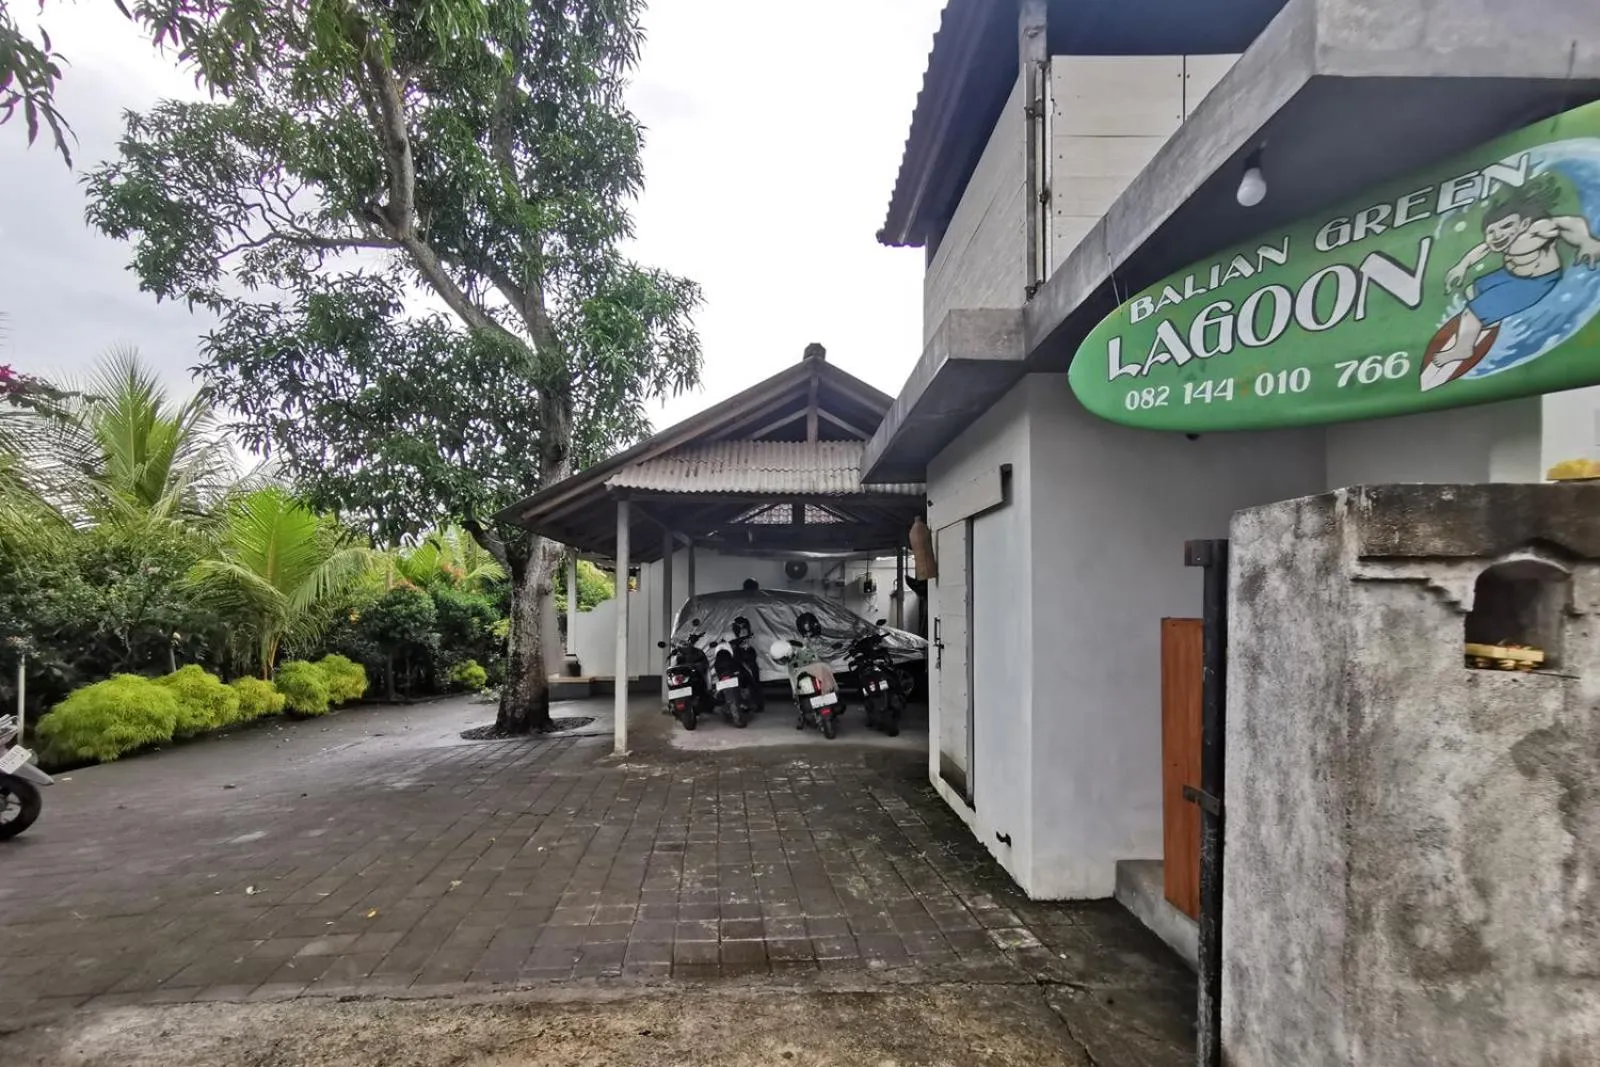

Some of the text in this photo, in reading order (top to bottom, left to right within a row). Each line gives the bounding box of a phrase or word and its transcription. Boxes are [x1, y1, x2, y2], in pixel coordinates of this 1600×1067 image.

[1107, 237, 1431, 381] LAGOON
[1130, 151, 1530, 324] BALIAN GREEN
[1125, 352, 1410, 411] 082 144 010 766
